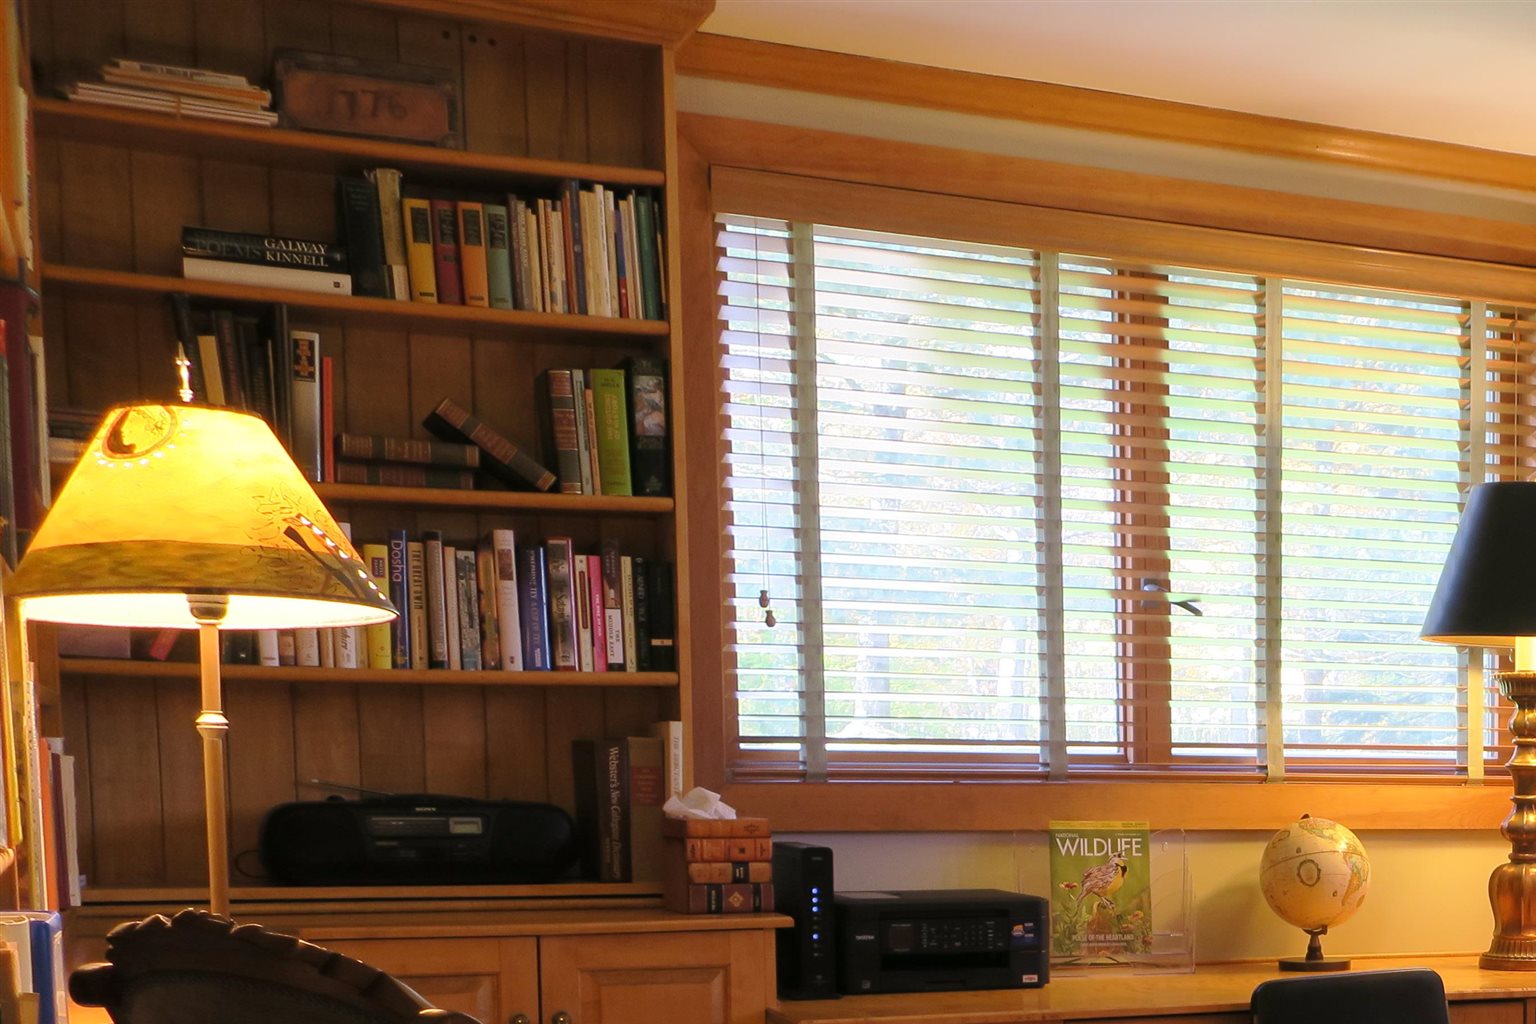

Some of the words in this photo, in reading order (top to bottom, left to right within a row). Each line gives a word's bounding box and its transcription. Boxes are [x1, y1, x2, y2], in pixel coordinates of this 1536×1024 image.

[263, 238, 328, 255] GALWAY
[265, 250, 329, 267] KINNELL
[391, 540, 404, 582] Dosha
[608, 746, 620, 788] Webster's
[1056, 837, 1143, 857] WILDLIFE
